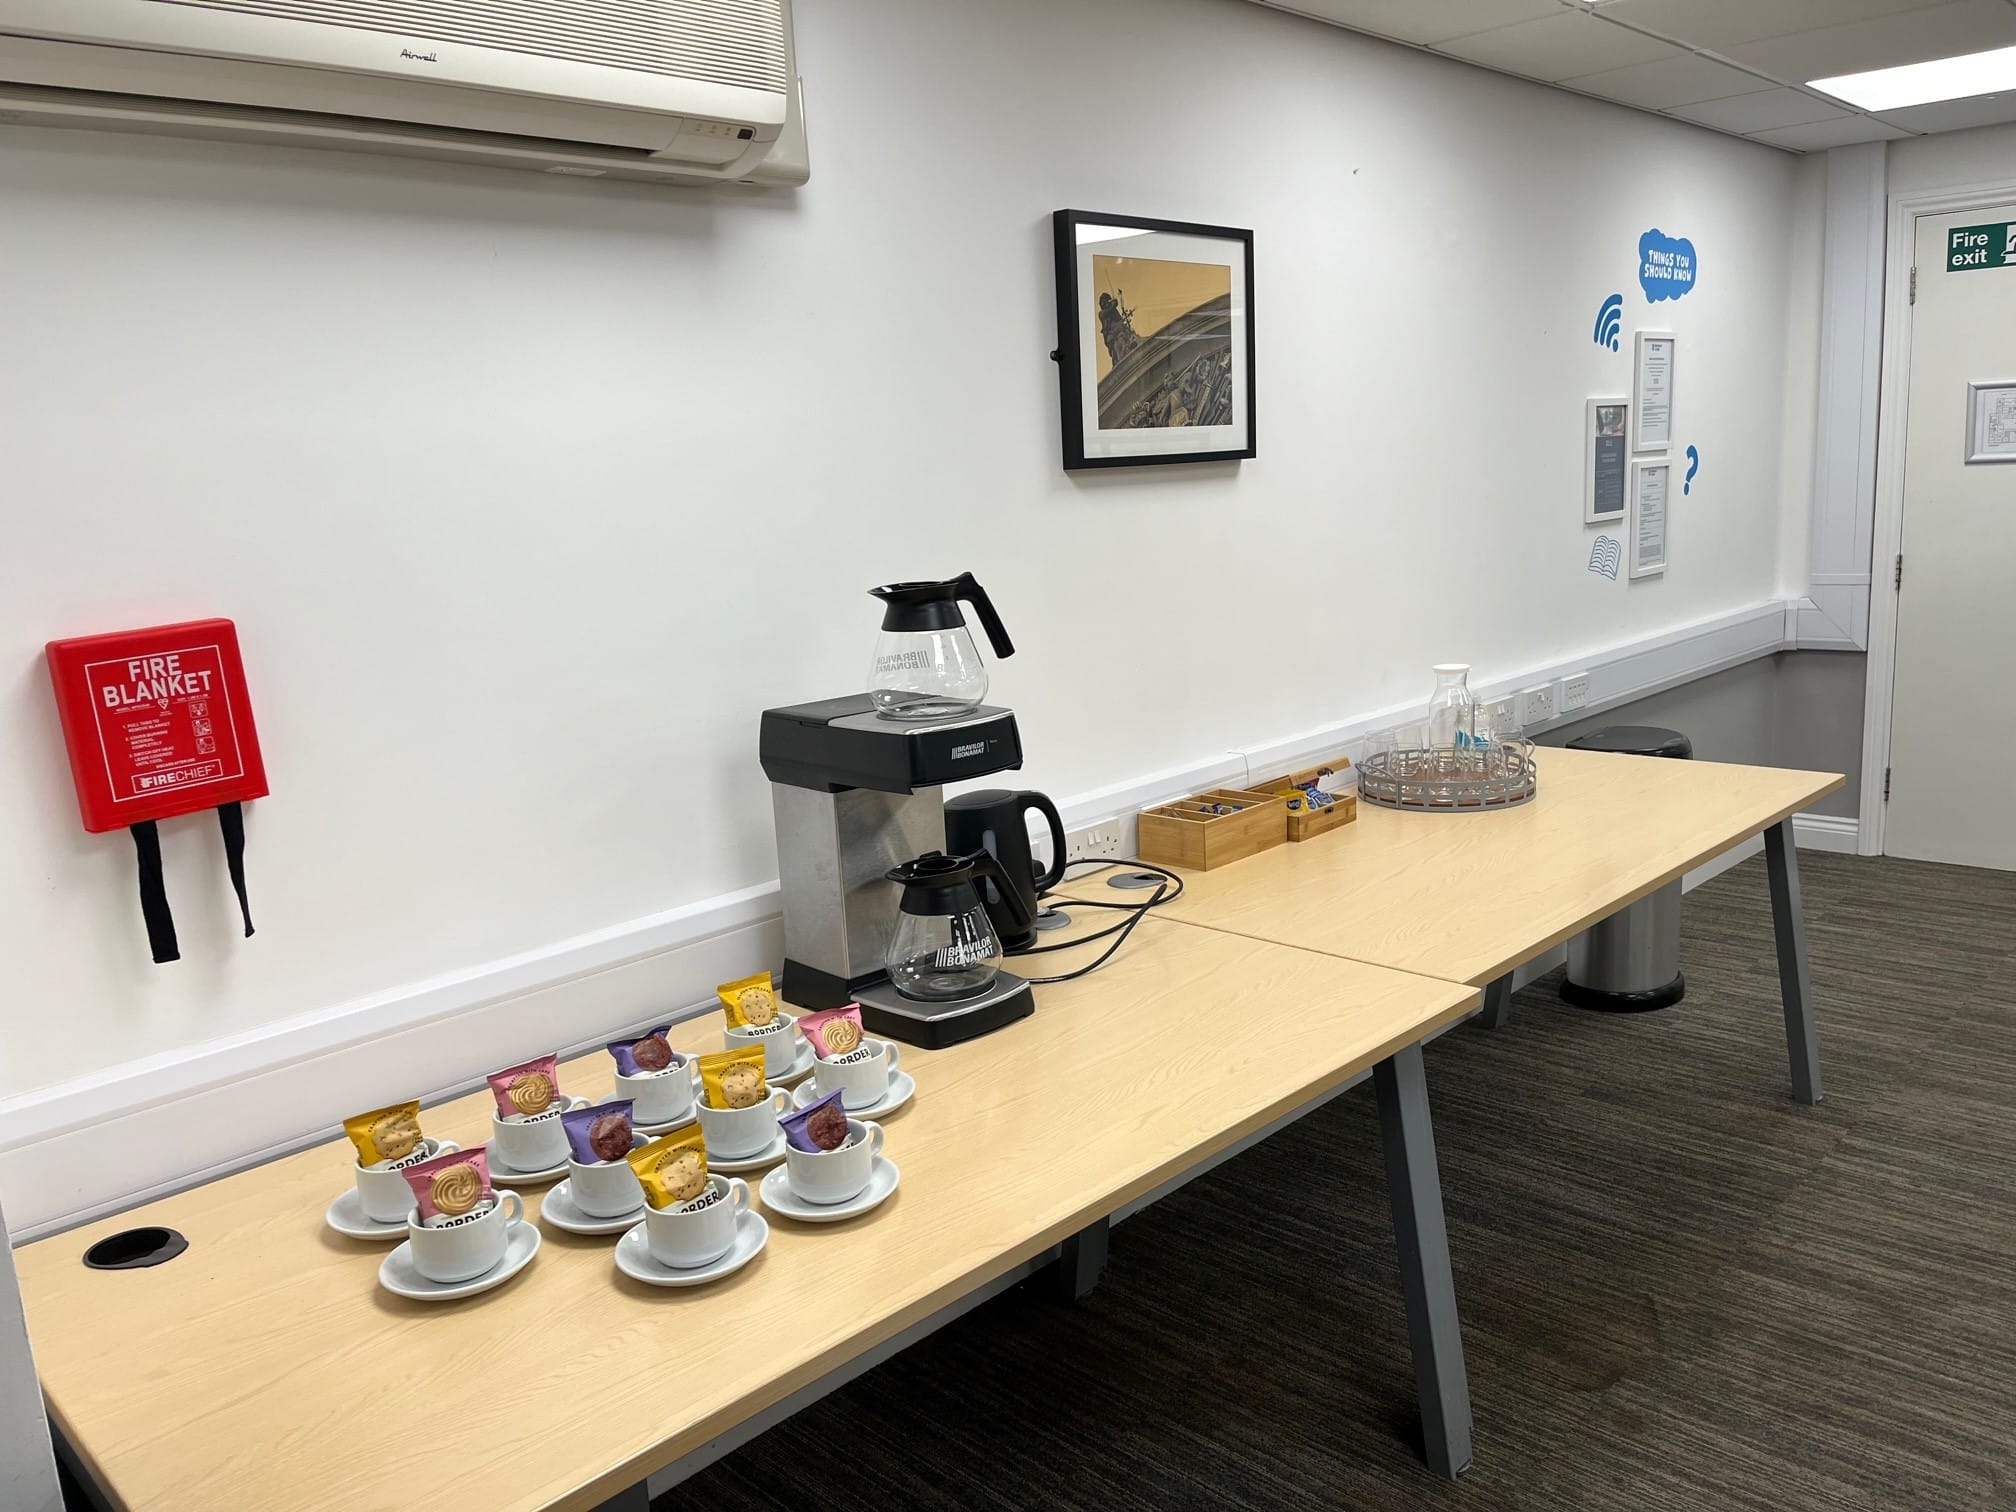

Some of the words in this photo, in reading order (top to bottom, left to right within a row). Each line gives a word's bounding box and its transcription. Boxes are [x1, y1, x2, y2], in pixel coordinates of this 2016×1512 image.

[400, 49, 437, 62] Airwell
[1952, 232, 1989, 249] Fire
[1648, 250, 1674, 267] THINGS
[1676, 254, 1690, 268] YOU
[1952, 249, 1988, 266] exit
[1644, 263, 1672, 280] SHOULD
[1673, 268, 1692, 282] KNOW
[128, 654, 182, 682] FIRE
[102, 670, 212, 708] BLANKET
[957, 741, 985, 753] BRAVILOR
[957, 747, 985, 759] BONAMAT
[146, 765, 213, 787] FIRECHIEF
[948, 936, 992, 957] BRAVILOR
[947, 945, 993, 967] BONAMAT
[833, 1048, 871, 1064] ORDER
[681, 1191, 719, 1213] ORDER
